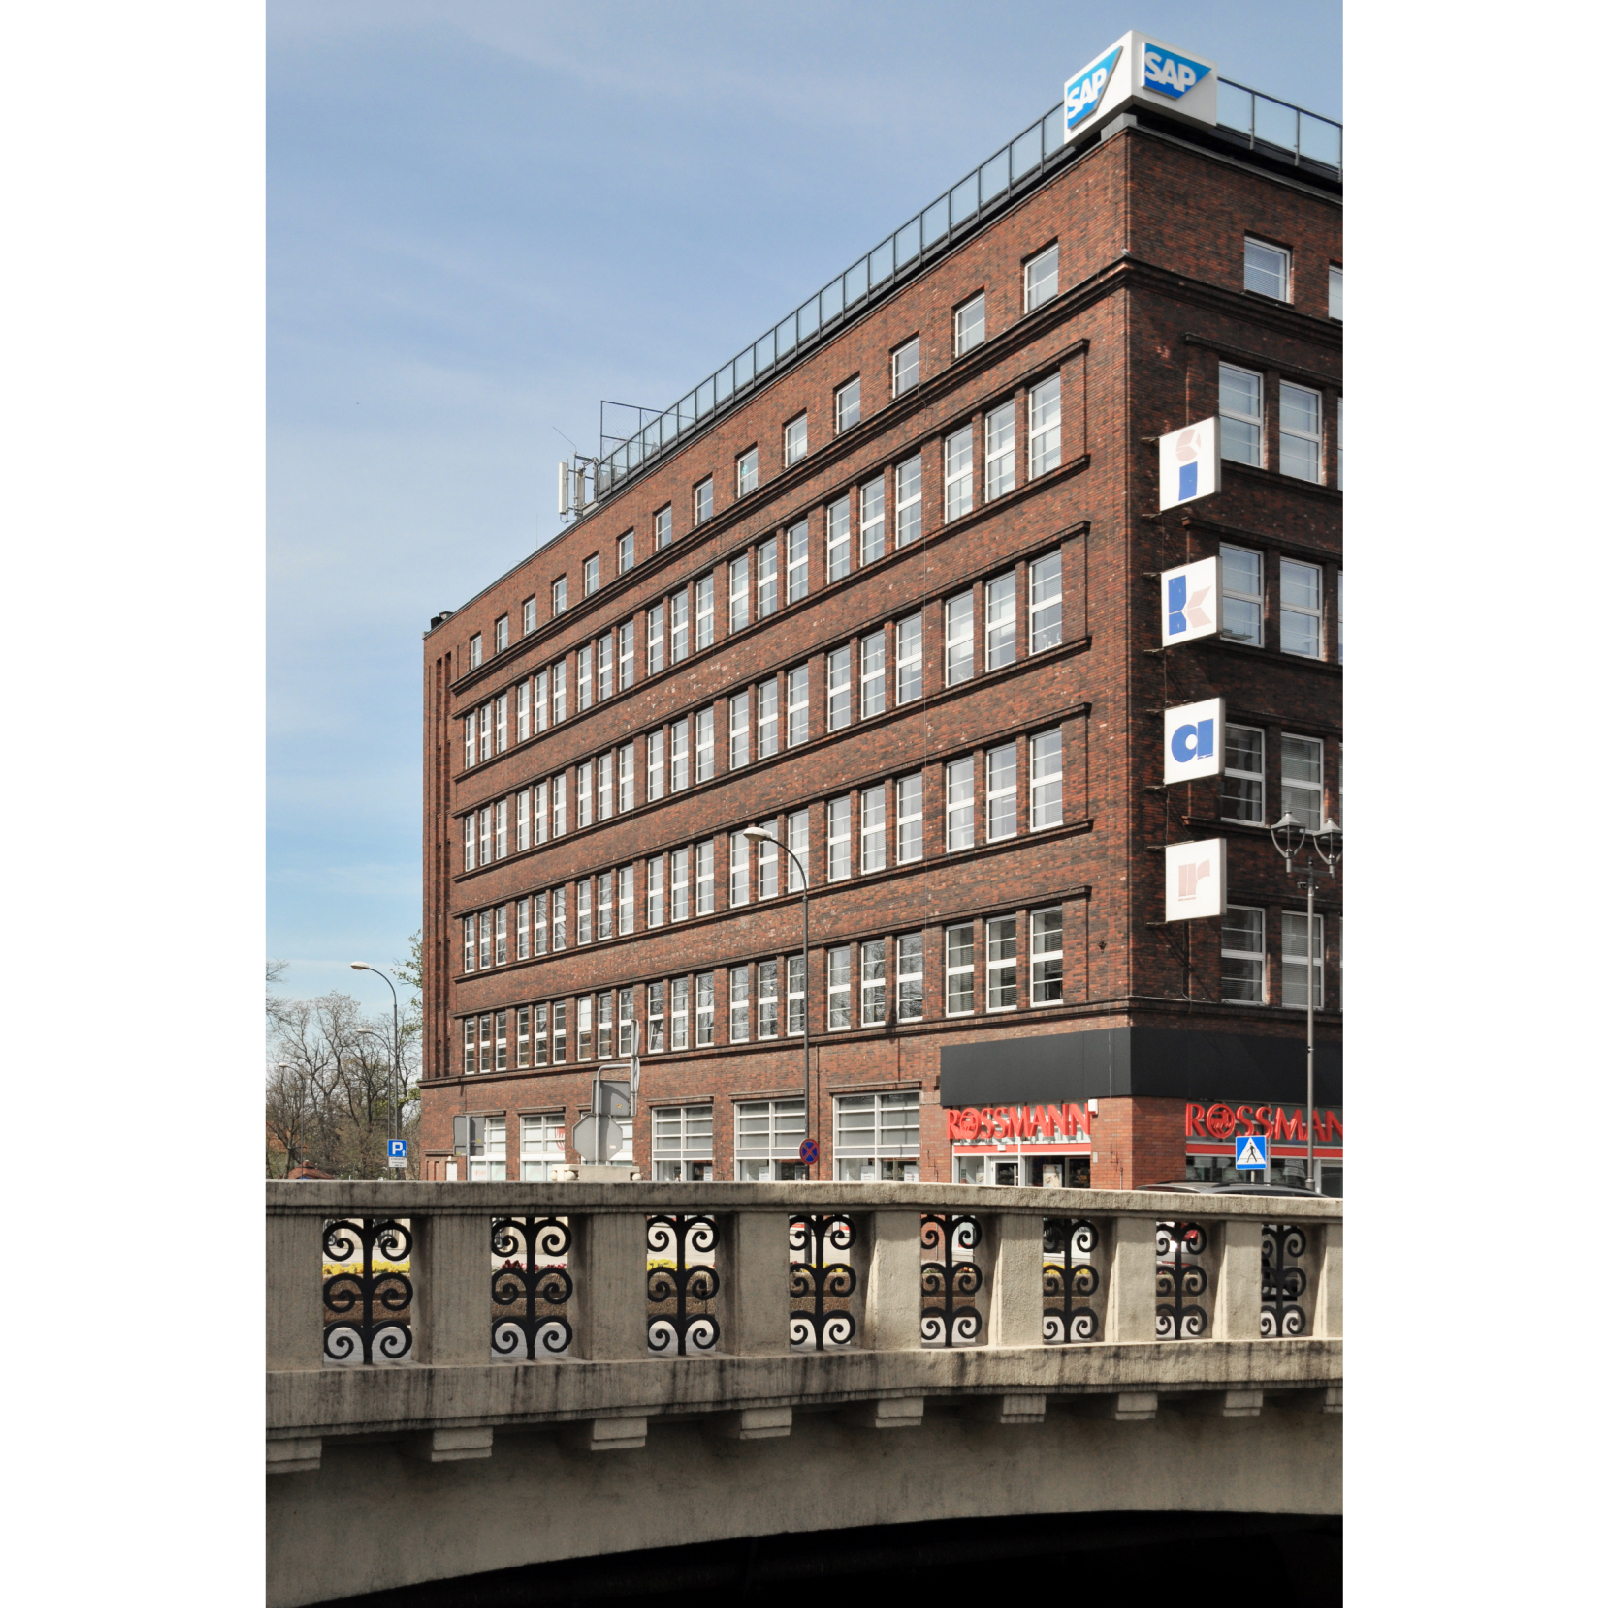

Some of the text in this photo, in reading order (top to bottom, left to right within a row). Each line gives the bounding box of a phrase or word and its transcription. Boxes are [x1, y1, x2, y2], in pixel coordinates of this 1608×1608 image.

[1145, 52, 1196, 92] SAP
[1067, 68, 1107, 120] SAP
[947, 1103, 1090, 1140] ROSSMANN
[392, 1142, 403, 1155] P
